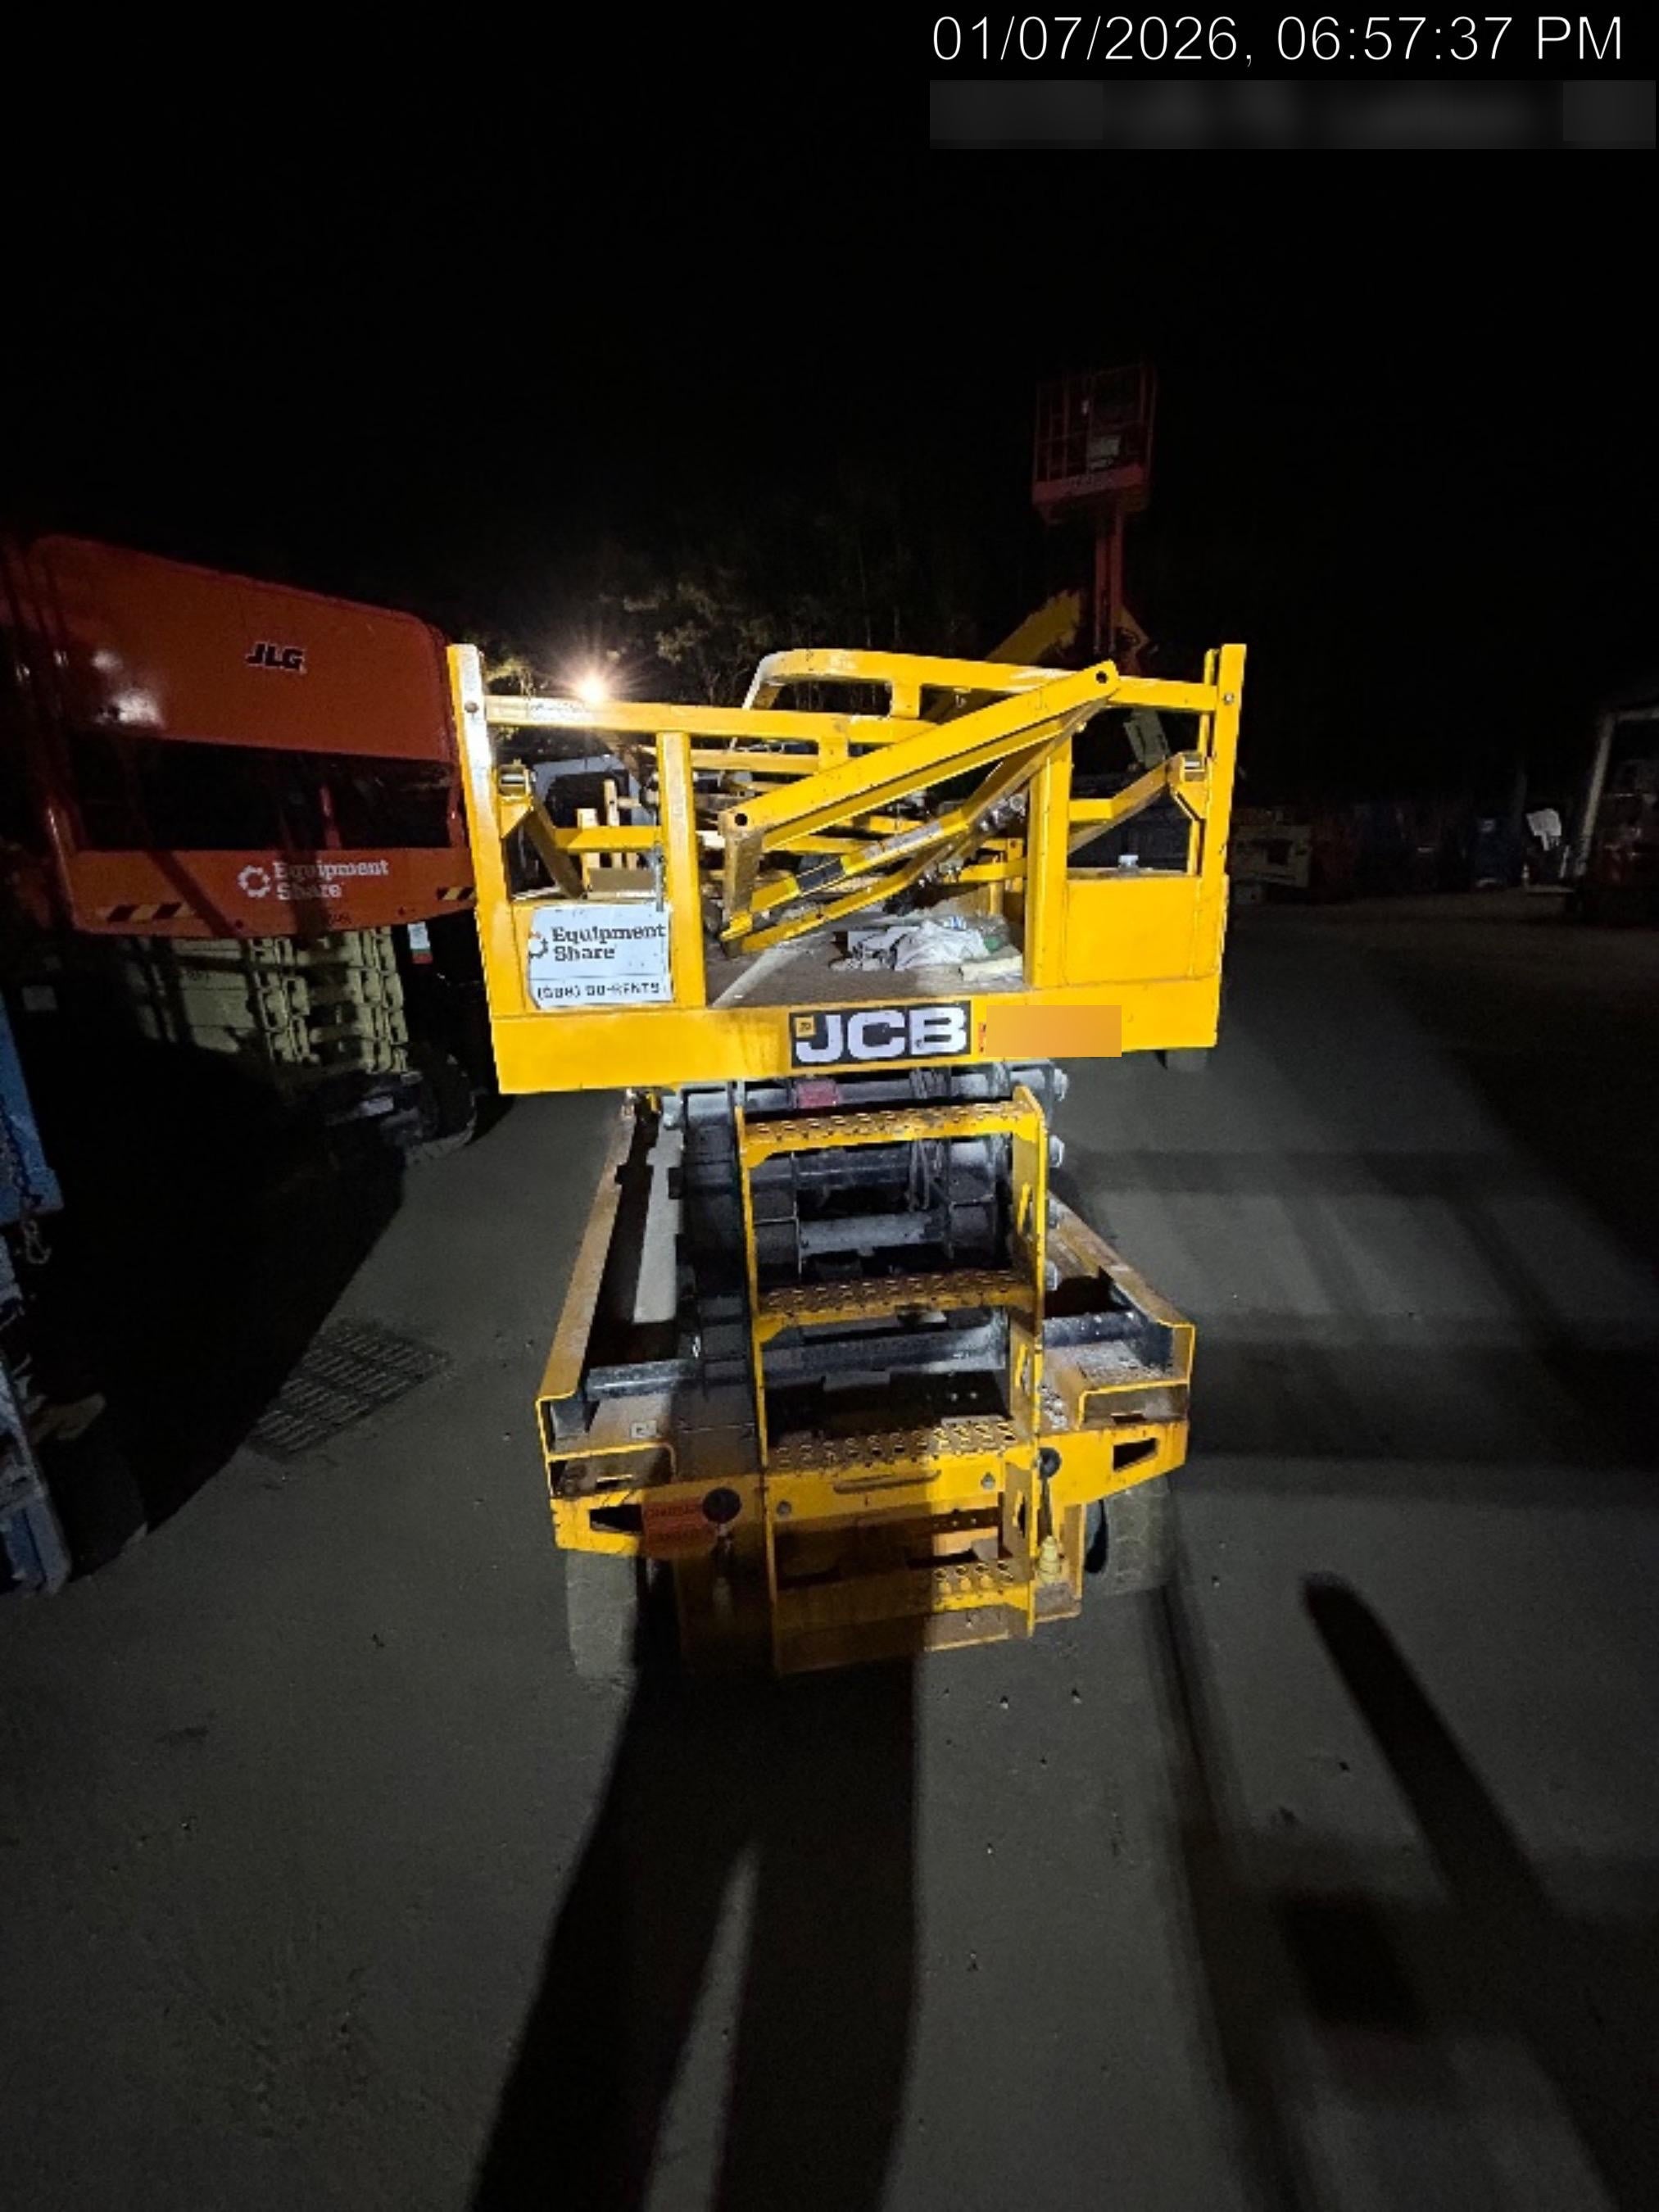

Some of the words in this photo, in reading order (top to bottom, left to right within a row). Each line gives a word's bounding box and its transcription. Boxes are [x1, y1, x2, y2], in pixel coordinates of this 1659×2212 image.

[246, 642, 306, 673] JLG
[273, 859, 389, 880] Equipment
[277, 882, 342, 900] Share
[551, 923, 667, 945] Equipment
[555, 945, 615, 962] Share
[795, 1007, 967, 1063] JCB
